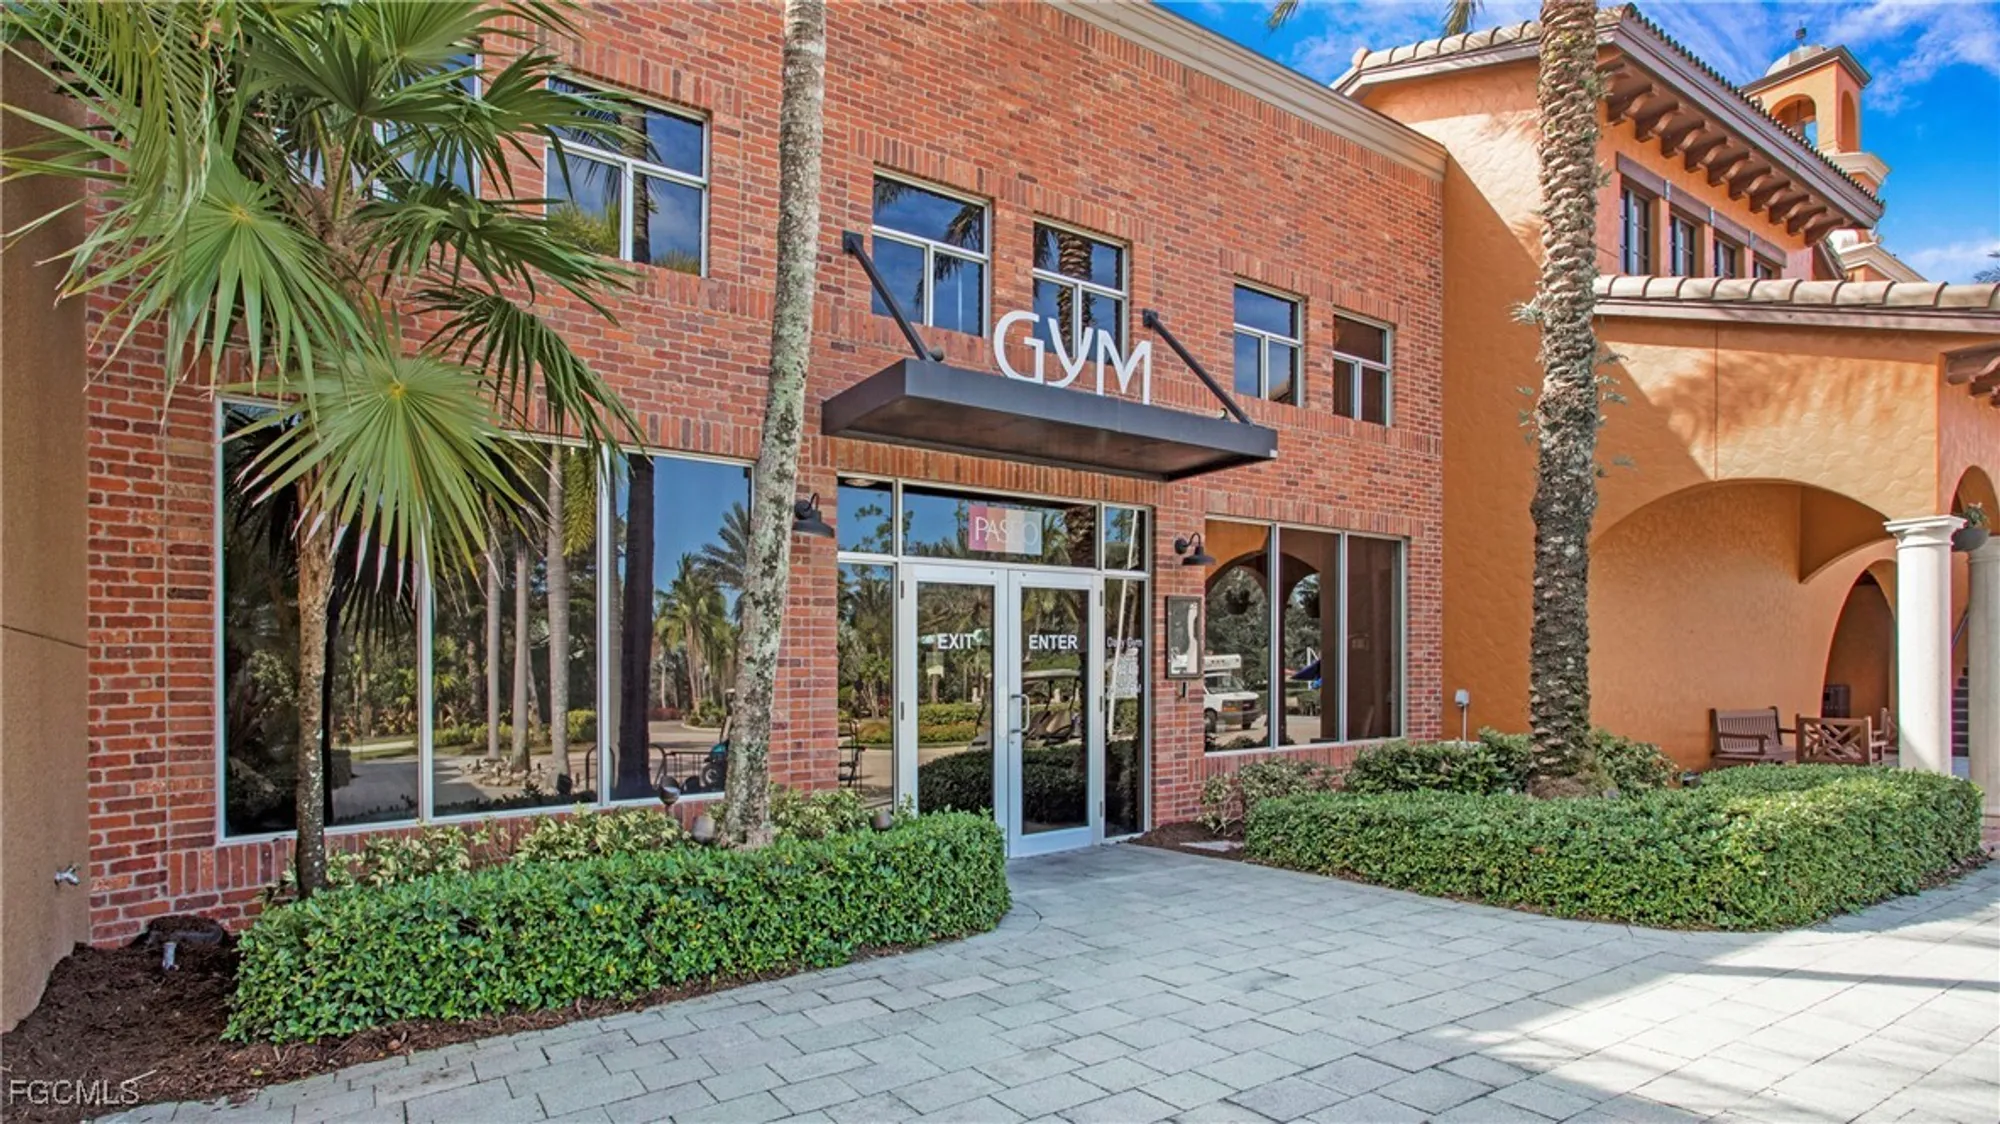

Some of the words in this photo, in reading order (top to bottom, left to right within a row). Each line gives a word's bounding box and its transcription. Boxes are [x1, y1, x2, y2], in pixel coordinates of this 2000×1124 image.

[975, 516, 1039, 546] PASO
[937, 632, 973, 650] EXIT
[1028, 634, 1078, 650] ENTER
